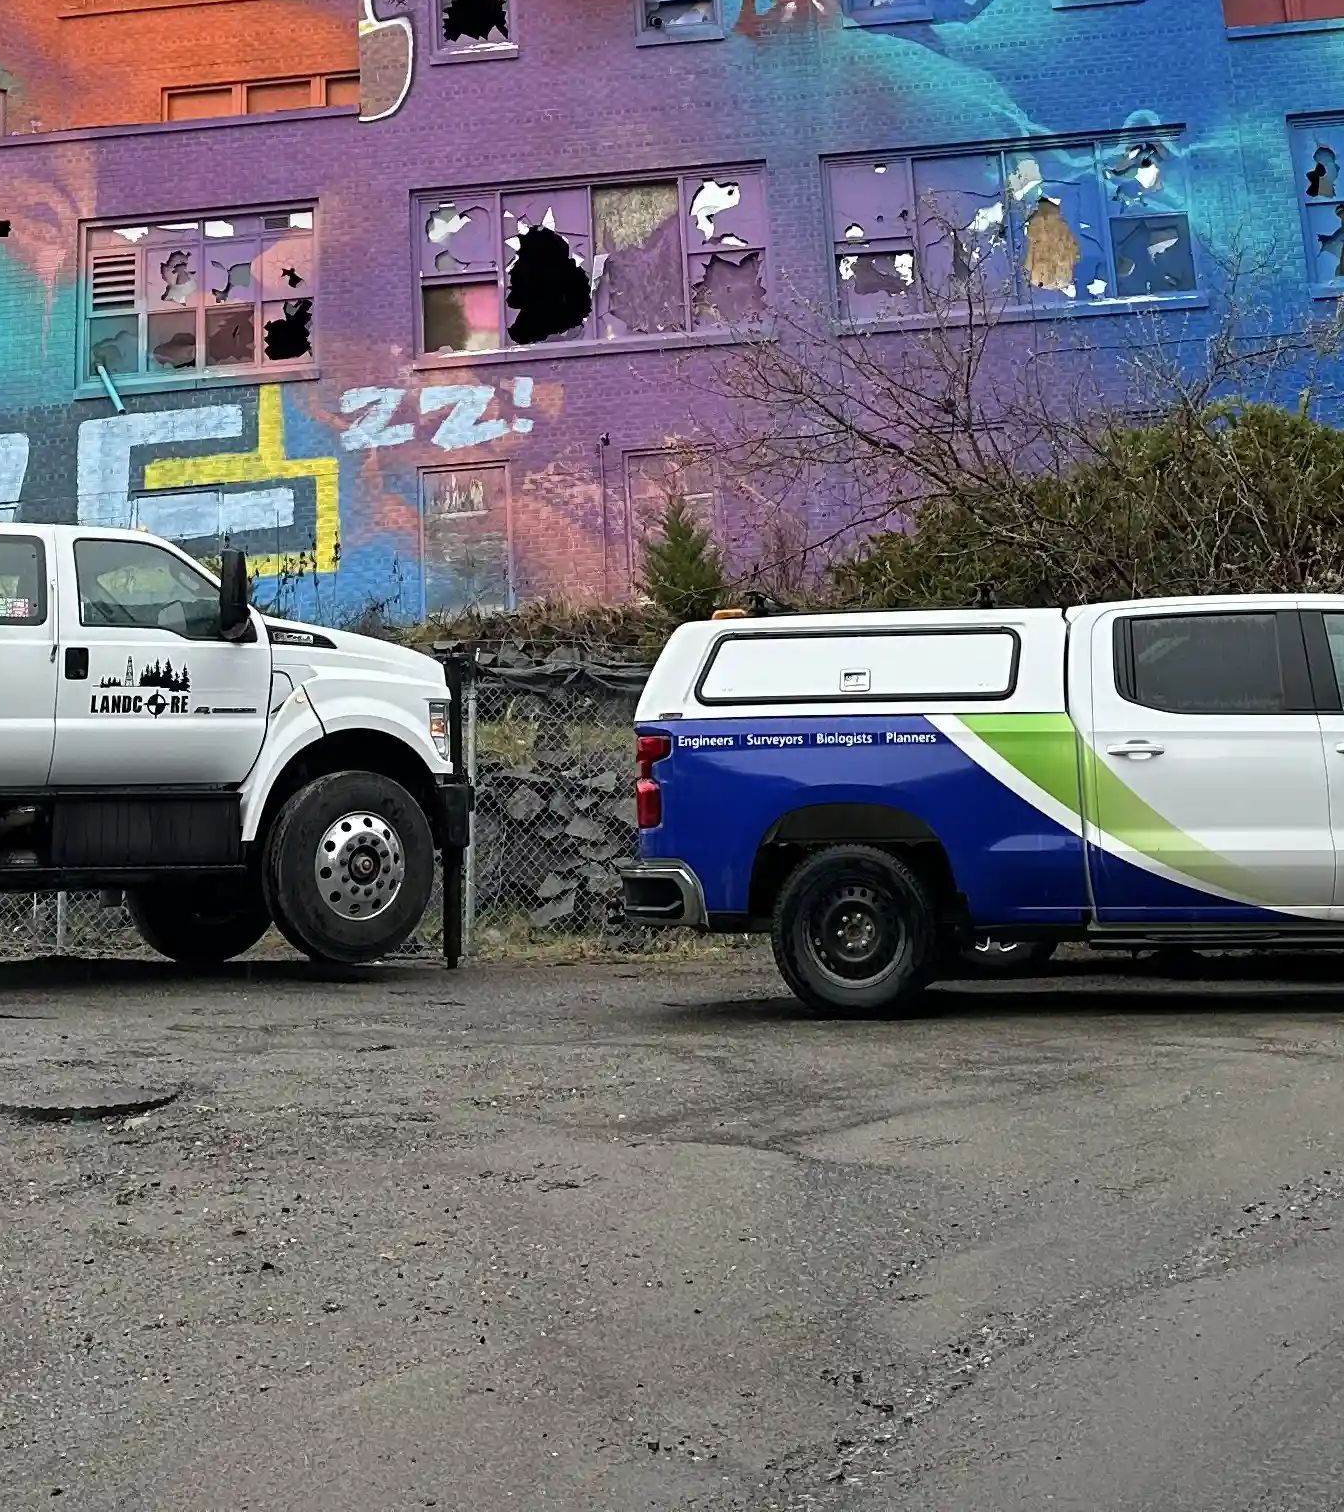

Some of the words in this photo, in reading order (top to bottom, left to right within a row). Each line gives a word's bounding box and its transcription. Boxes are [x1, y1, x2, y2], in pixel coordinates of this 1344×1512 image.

[678, 735, 734, 748] Engineers
[746, 733, 804, 747] Surveyors
[816, 733, 873, 746] Biologists
[885, 731, 936, 744] Planners
